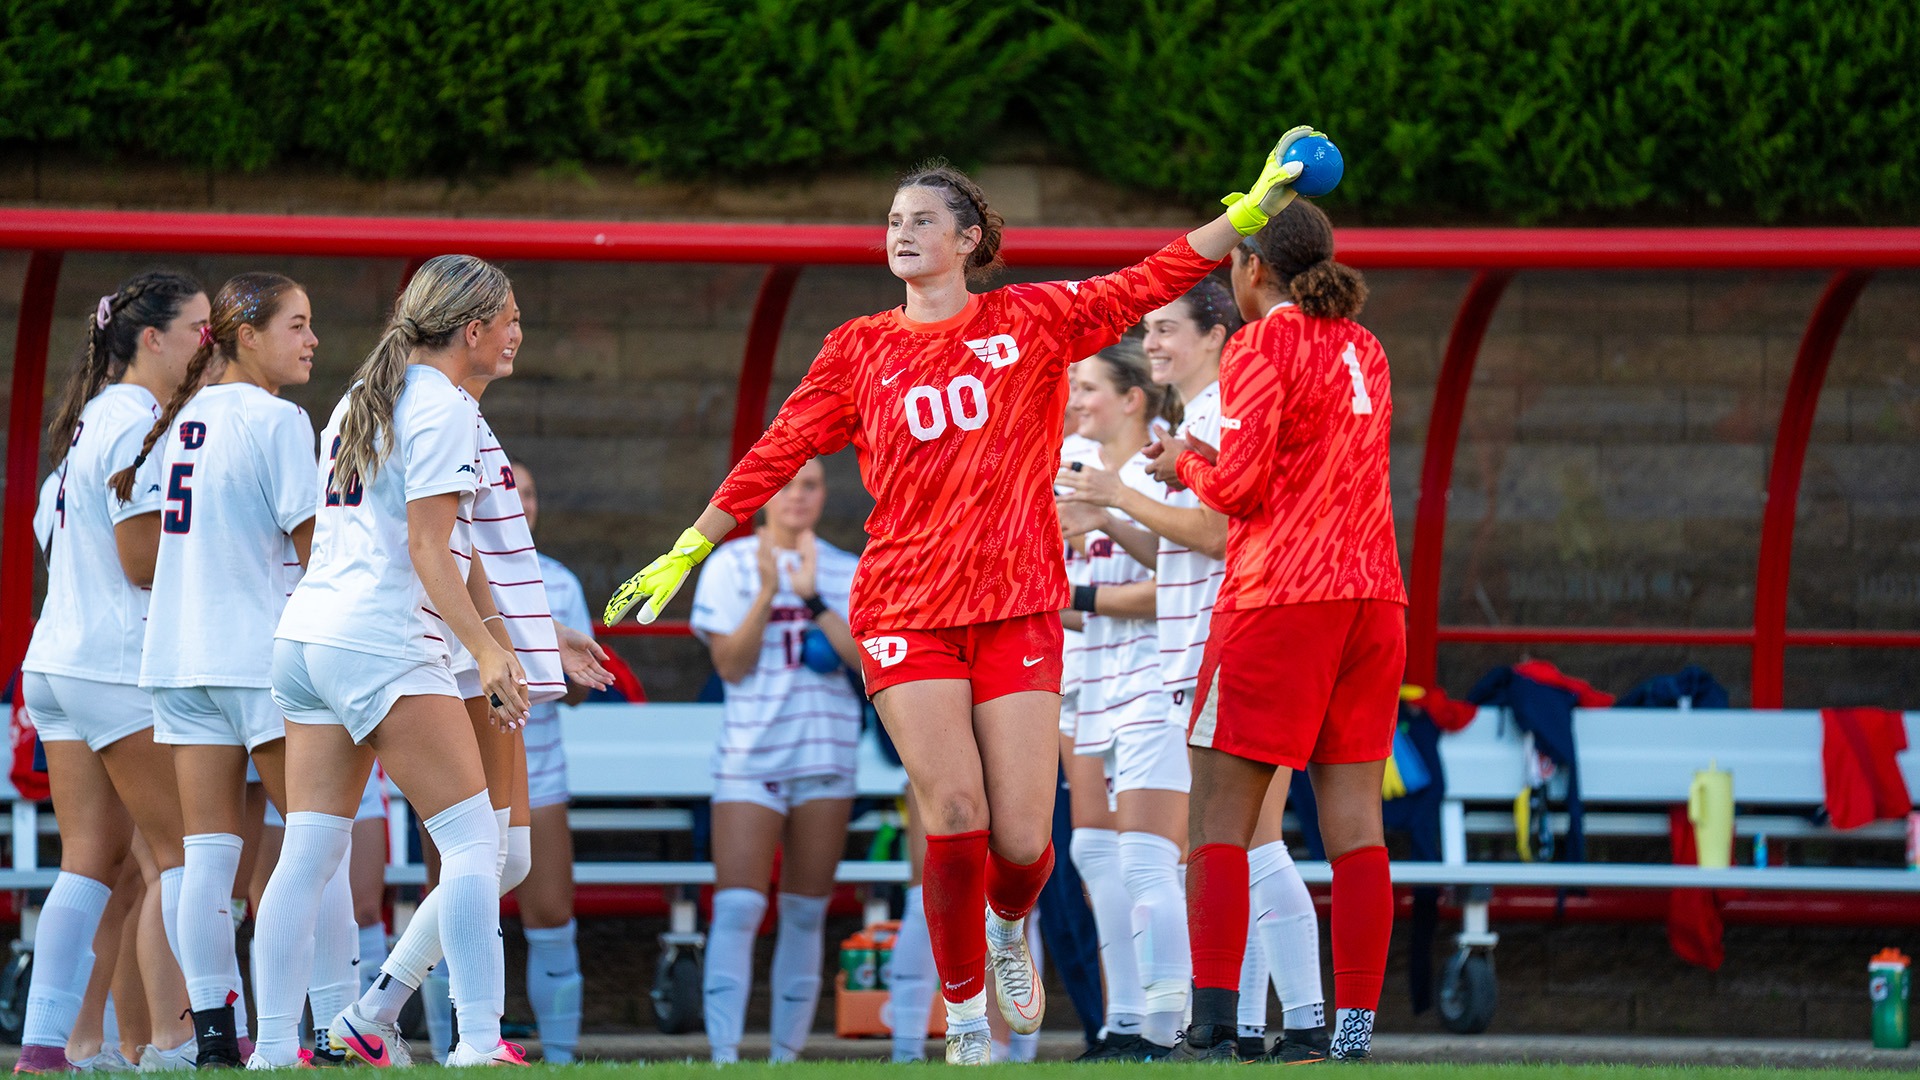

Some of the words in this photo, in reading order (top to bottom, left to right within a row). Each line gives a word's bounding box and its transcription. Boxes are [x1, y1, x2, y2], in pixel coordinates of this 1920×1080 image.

[904, 375, 989, 442] 00
[1342, 342, 1373, 414] 1
[163, 463, 194, 534] 5
